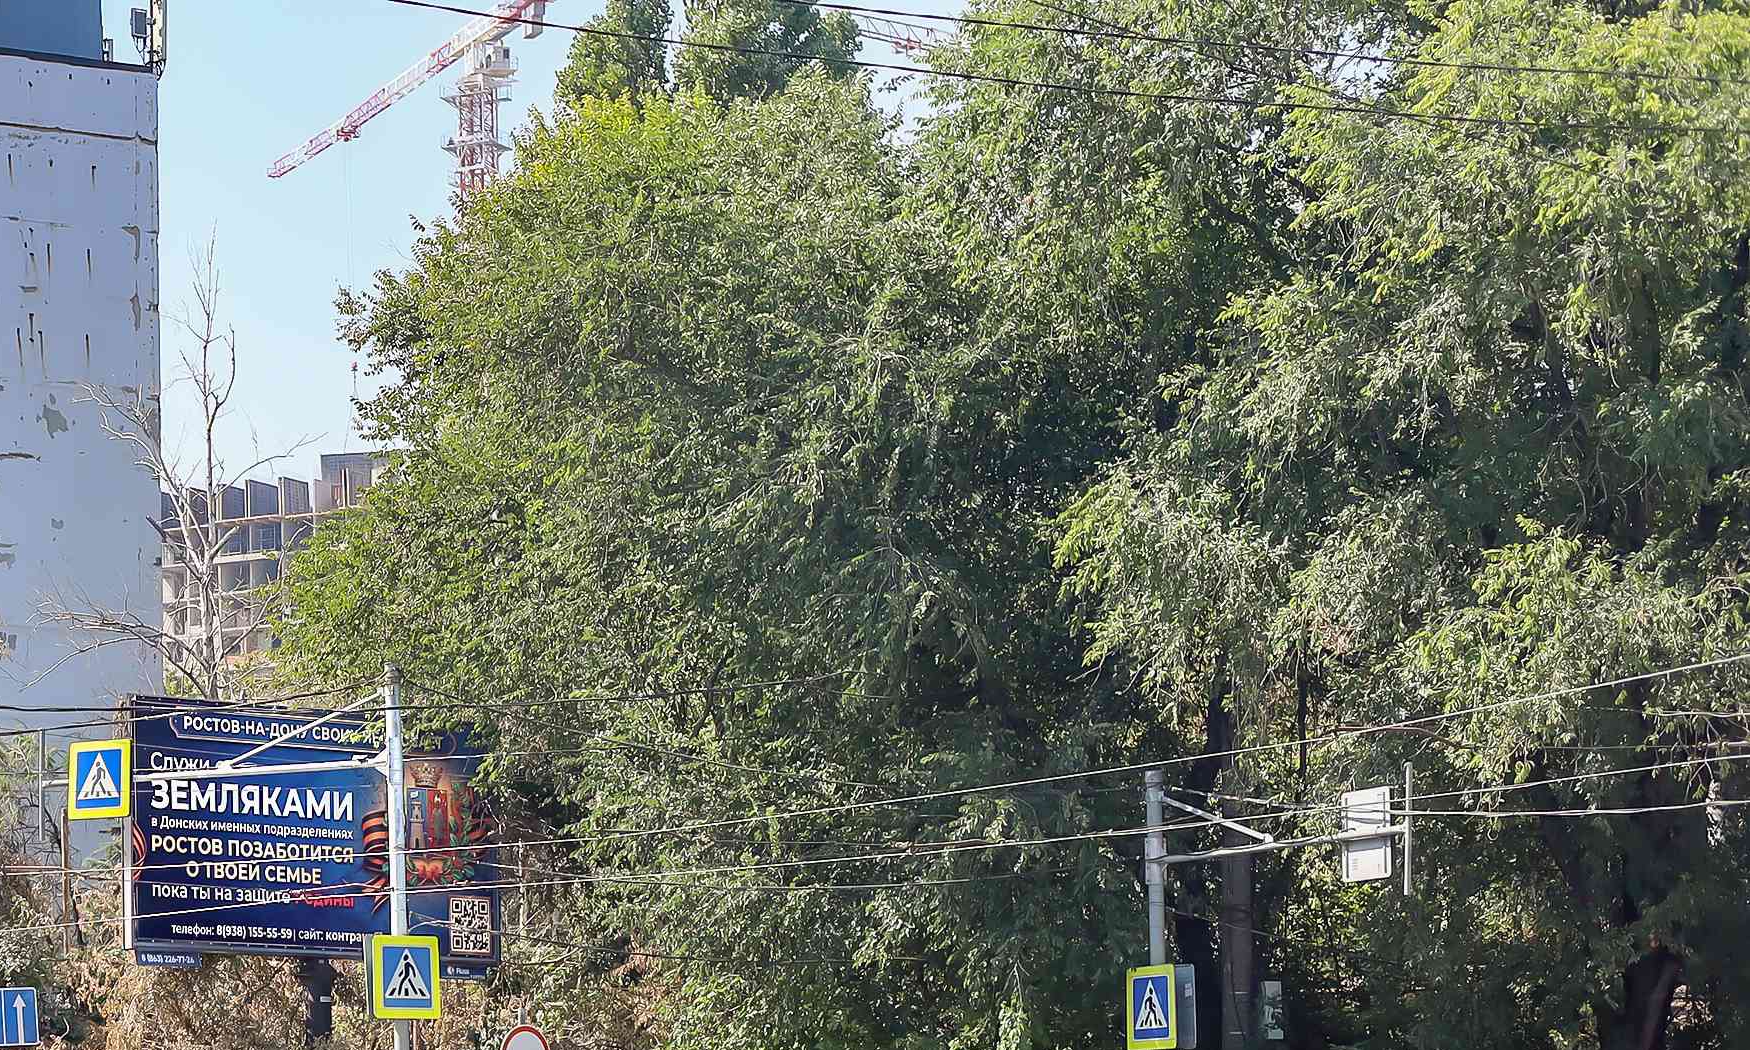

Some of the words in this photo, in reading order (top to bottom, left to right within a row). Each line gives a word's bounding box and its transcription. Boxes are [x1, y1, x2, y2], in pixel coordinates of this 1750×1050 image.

[183, 715, 308, 740] РОСТОВ-НА-ДОНУ
[150, 752, 209, 771] Служи
[151, 779, 353, 821] ЗЕМЛЯКАМИ
[151, 817, 158, 827] в
[160, 815, 208, 831] Донских
[210, 820, 261, 834] именных
[263, 824, 354, 840] подразделениях
[151, 835, 223, 856] РОСТОВ
[228, 840, 354, 864] ПОЗАБОТИТСЯ
[185, 861, 199, 878] О
[205, 862, 260, 881] ТВОЕЙ
[264, 865, 322, 885] СЕМЬЕ
[152, 884, 188, 899] пока
[191, 886, 210, 900] ты
[214, 888, 233, 901] на
[236, 888, 290, 904] защите
[171, 922, 215, 937] телефон:
[298, 928, 323, 941] сайт:
